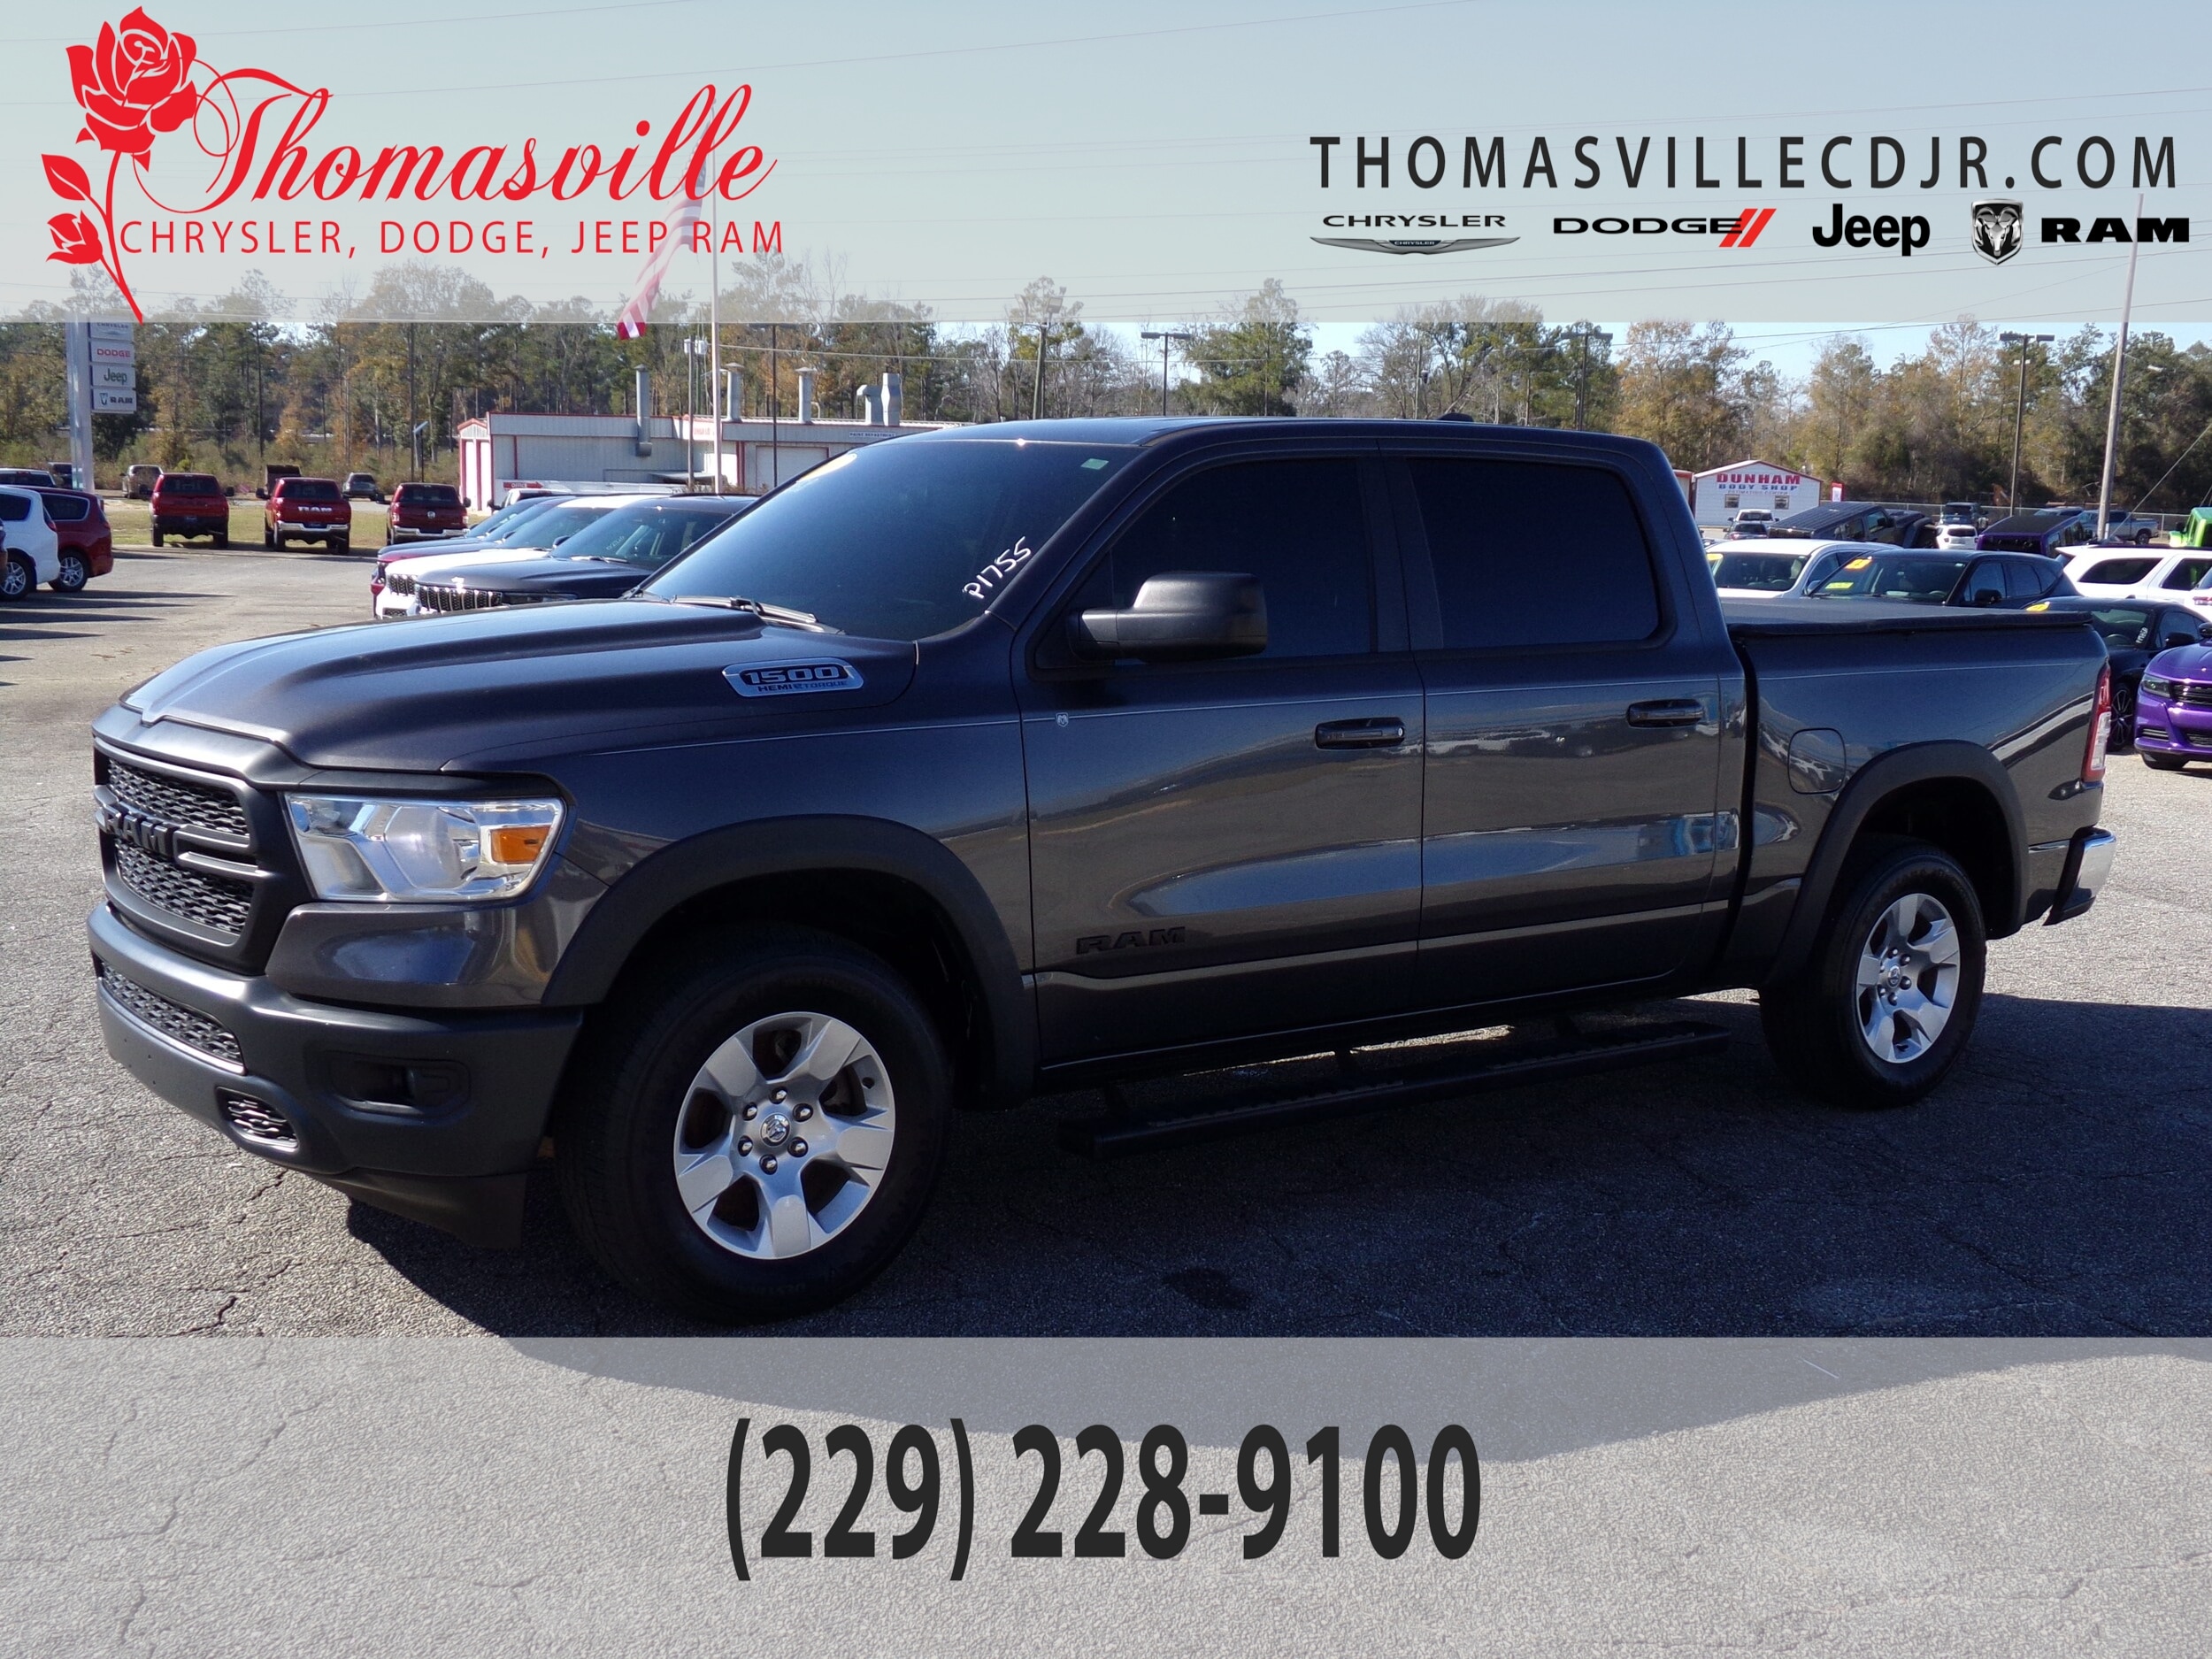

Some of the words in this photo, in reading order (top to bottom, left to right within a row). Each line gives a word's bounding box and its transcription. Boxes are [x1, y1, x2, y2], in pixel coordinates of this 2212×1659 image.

[96, 348, 131, 357] DODGE
[104, 368, 127, 385] Jeep
[1717, 473, 1801, 484] DUNHAM
[746, 666, 840, 684] 1500
[104, 803, 171, 858] RAM
[1076, 926, 1186, 955] RAM
